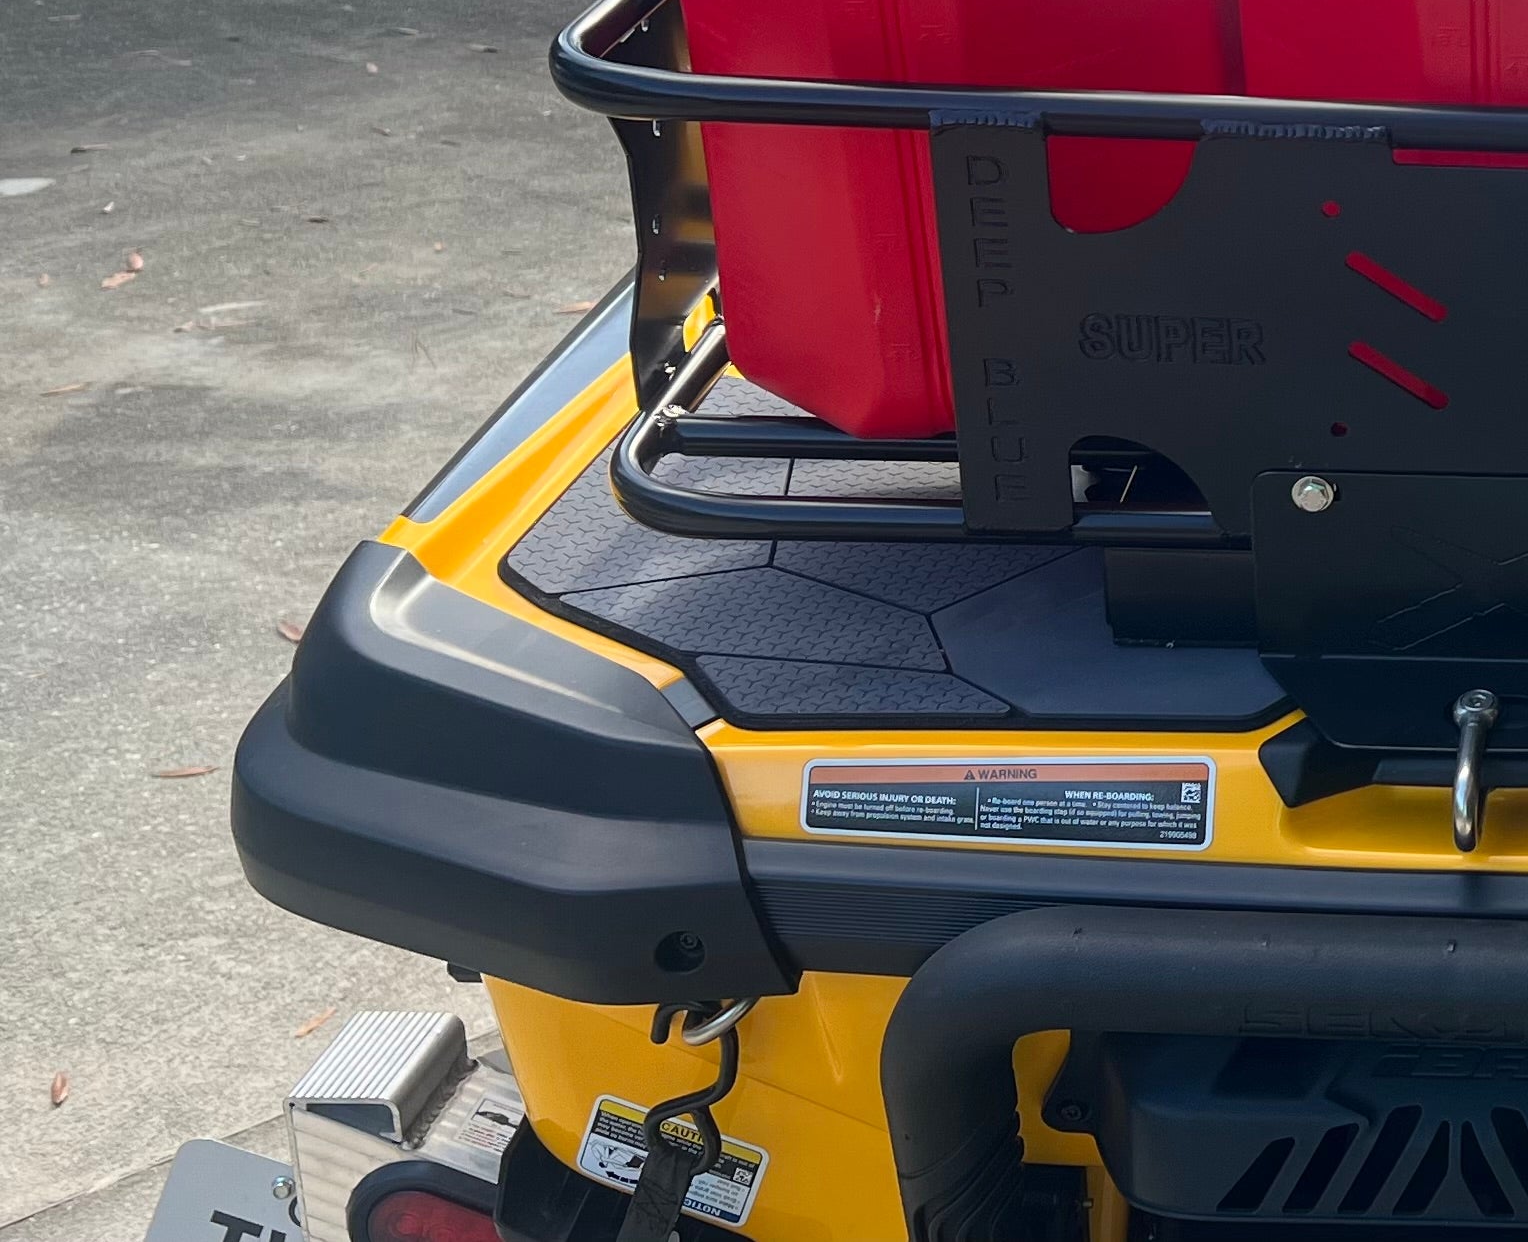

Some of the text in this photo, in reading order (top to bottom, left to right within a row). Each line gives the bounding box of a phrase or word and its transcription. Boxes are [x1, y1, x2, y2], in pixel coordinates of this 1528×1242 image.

[1078, 311, 1267, 366] SUPER
[978, 768, 1038, 780] WARNING
[813, 789, 956, 805] AVOID SERIOUS INJURY OR DEATH:
[1064, 790, 1154, 802] WHEN RE-BOARDING:
[662, 1123, 702, 1142] CAUTI
[683, 1198, 720, 1216] NOTIC
